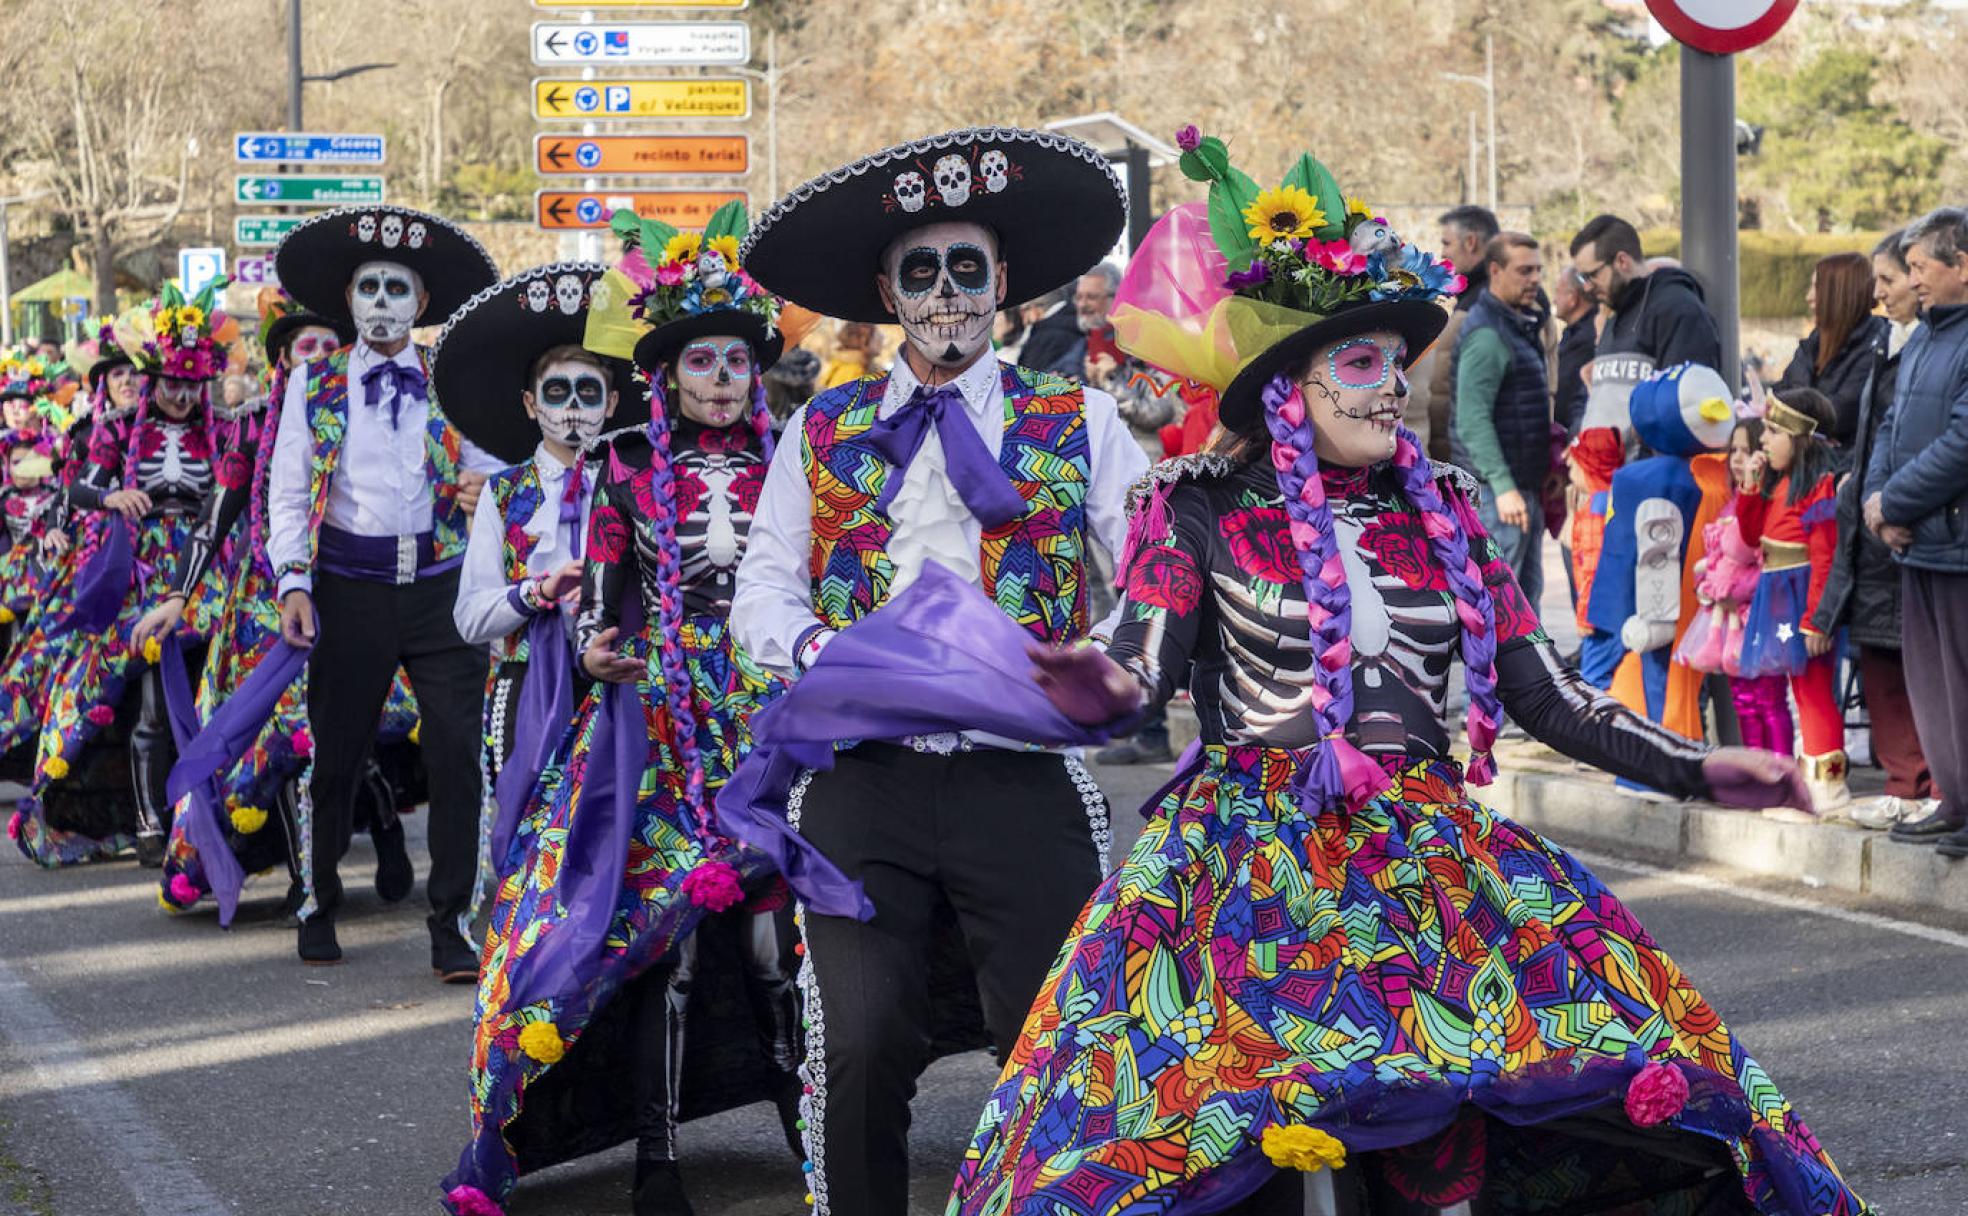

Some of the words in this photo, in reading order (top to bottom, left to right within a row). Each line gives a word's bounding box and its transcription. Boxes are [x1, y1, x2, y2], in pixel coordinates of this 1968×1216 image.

[688, 86, 740, 96] parking
[634, 151, 690, 161] recinto
[700, 150, 742, 161] ferial
[683, 204, 699, 214] de
